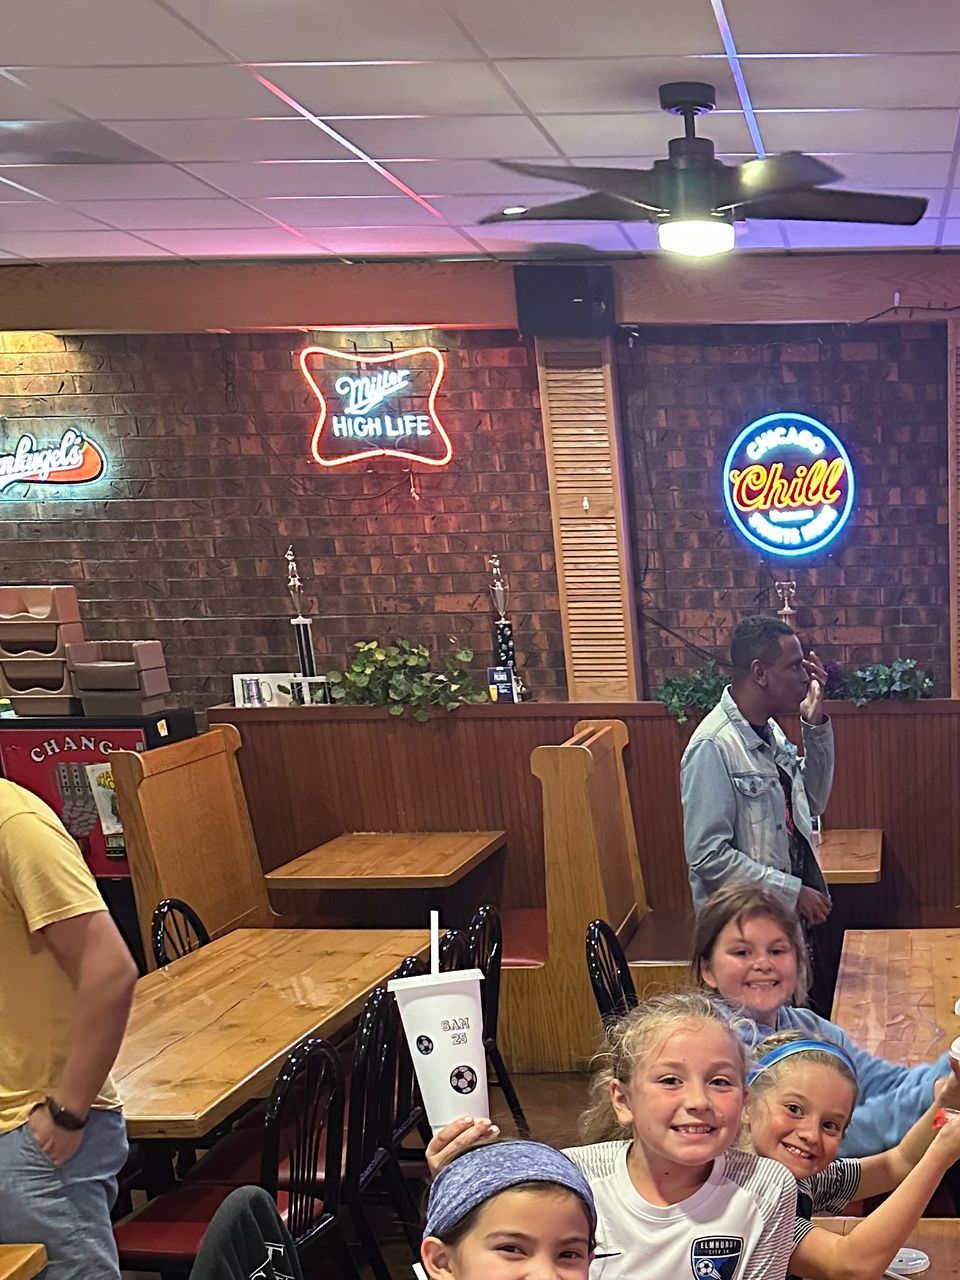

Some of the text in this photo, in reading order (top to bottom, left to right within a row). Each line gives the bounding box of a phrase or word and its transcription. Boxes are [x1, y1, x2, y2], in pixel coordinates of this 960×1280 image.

[335, 369, 410, 415] Miller
[332, 414, 432, 437] HIGH LIFE
[746, 426, 826, 460] CHICAGO
[730, 457, 845, 512] Chill
[30, 736, 121, 762] CHANG
[440, 1017, 470, 1031] SAM
[700, 1239, 738, 1250] ELMHURST
